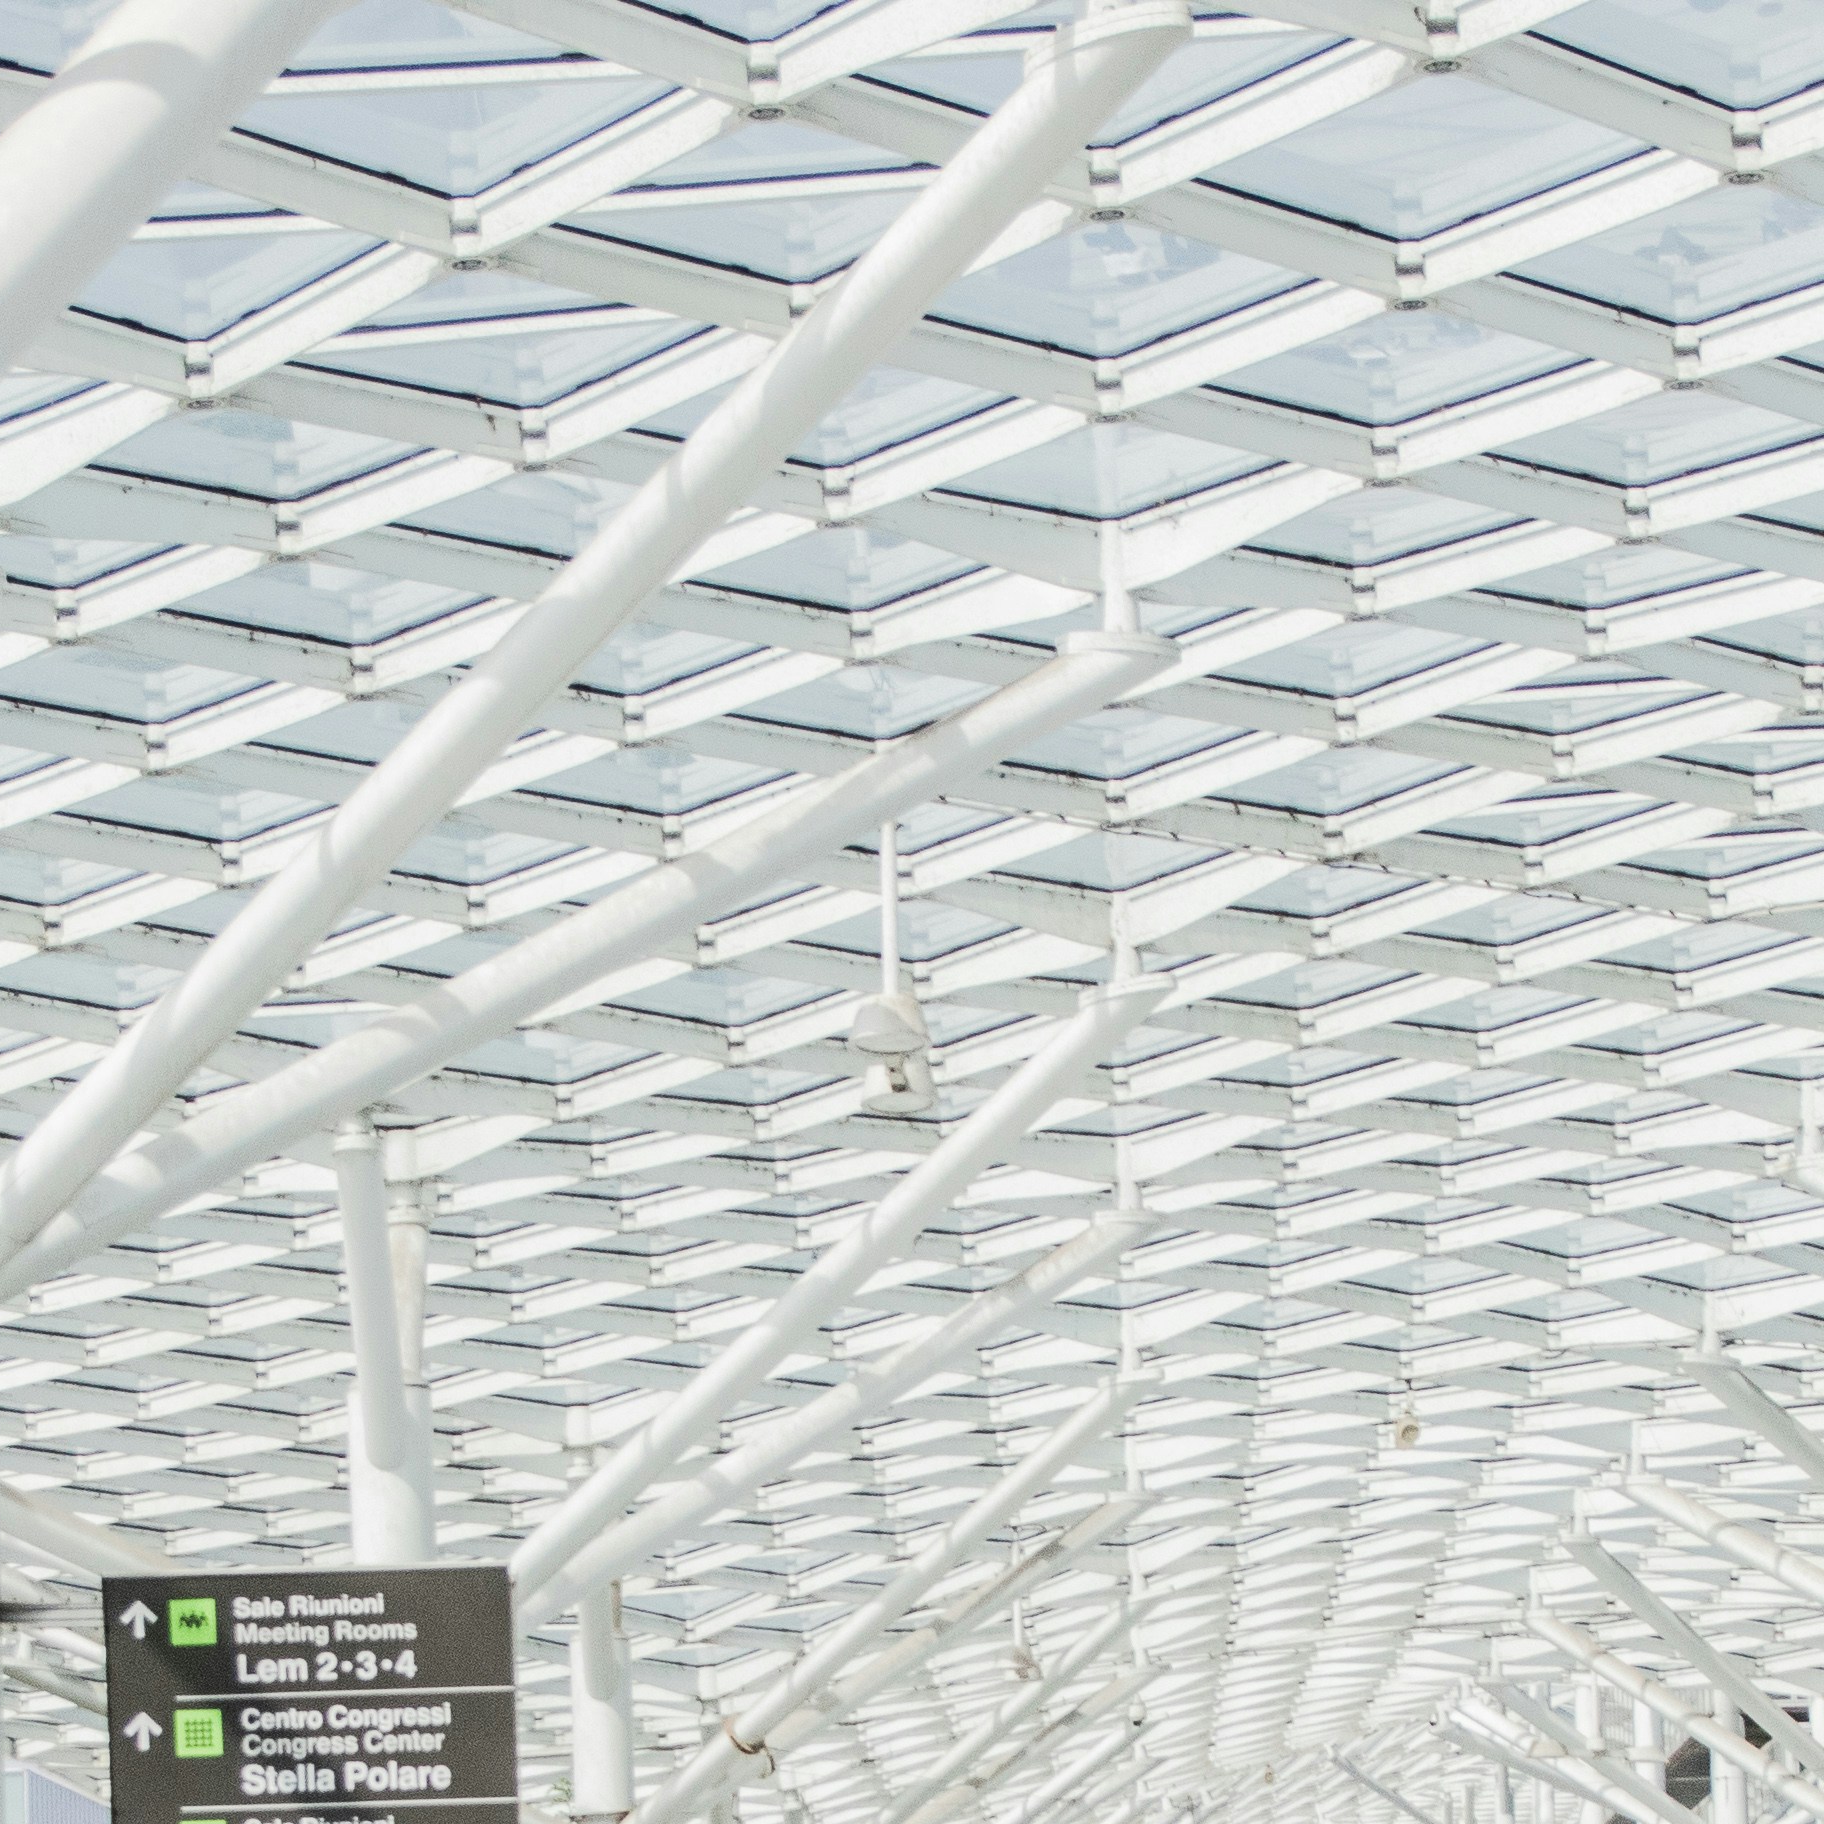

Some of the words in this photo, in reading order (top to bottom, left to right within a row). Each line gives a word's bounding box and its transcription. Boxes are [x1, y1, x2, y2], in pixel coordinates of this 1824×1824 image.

[232, 1596, 285, 1619] Sale
[288, 1592, 384, 1616] Riunioni
[234, 1621, 330, 1647] Meeting
[334, 1620, 418, 1641] Rooms
[236, 1653, 309, 1683] Lem
[240, 1707, 323, 1731] Centro
[327, 1701, 451, 1733] Congressi
[242, 1733, 359, 1760] Congress
[363, 1729, 446, 1754] Center
[240, 1762, 335, 1796] Stella
[344, 1759, 451, 1792] Polare
